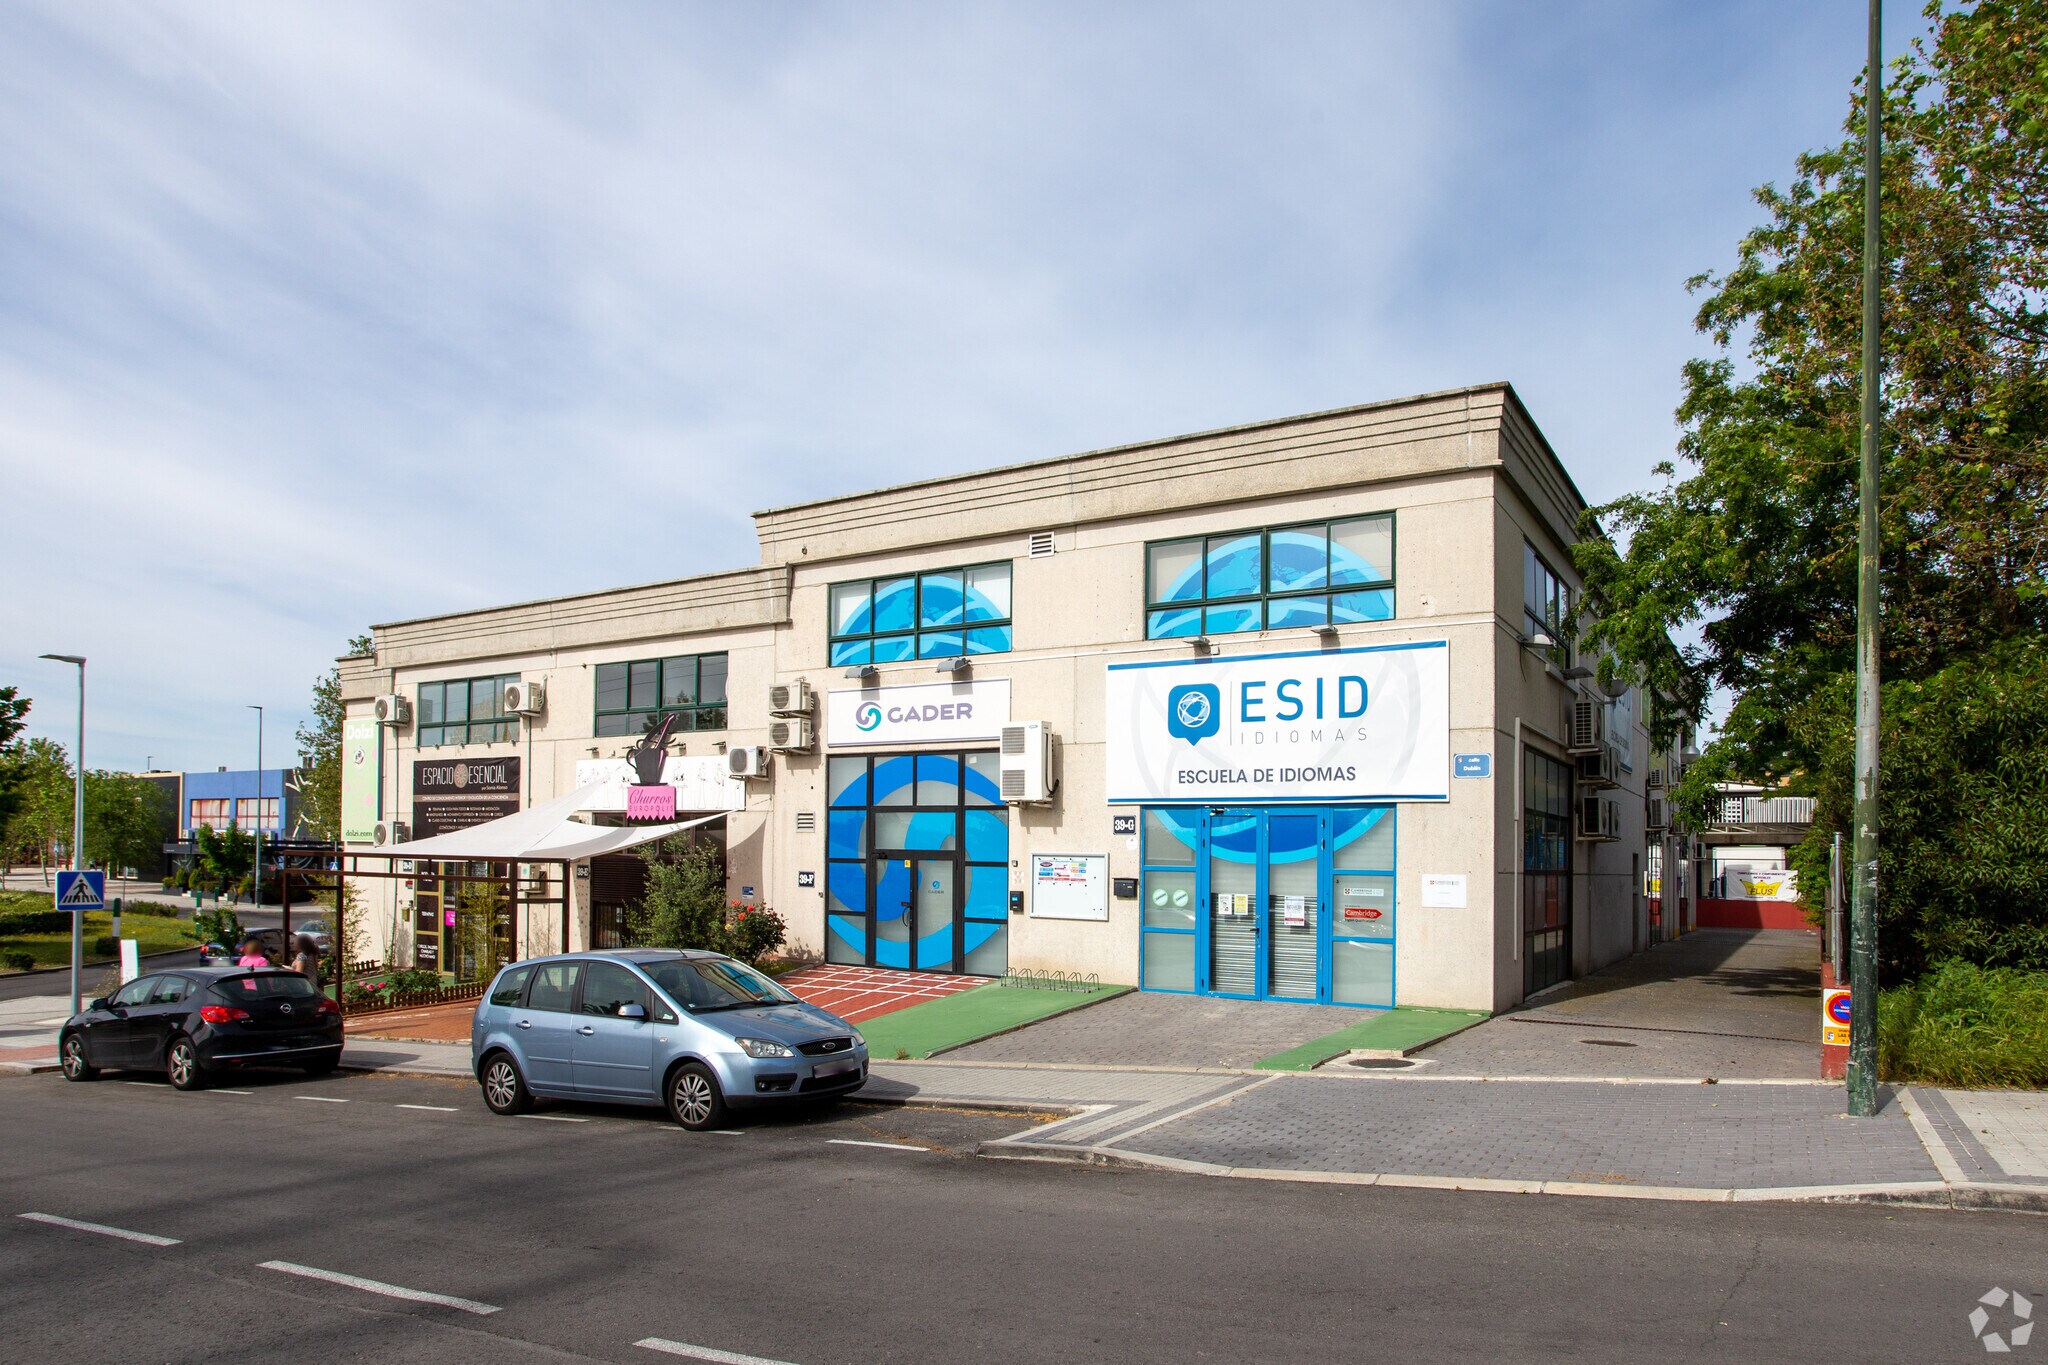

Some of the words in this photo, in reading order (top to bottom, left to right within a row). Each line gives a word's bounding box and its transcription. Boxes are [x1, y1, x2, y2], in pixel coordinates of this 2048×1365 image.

[1241, 675, 1368, 722] ESID
[887, 702, 973, 723] GADER
[346, 724, 374, 740] Dolzi
[1240, 728, 1367, 744] IDIOMAS
[422, 767, 454, 785] ESPACIO
[468, 765, 507, 784] ESENCIAL
[1178, 769, 1248, 784] ESCUELA
[1253, 768, 1274, 783] DE
[1279, 766, 1356, 783] IDIOMAS
[629, 789, 672, 805] Churros
[345, 829, 373, 837] dolzi.com
[1114, 819, 1135, 831] 39-G
[1345, 909, 1378, 918] Cambridge
